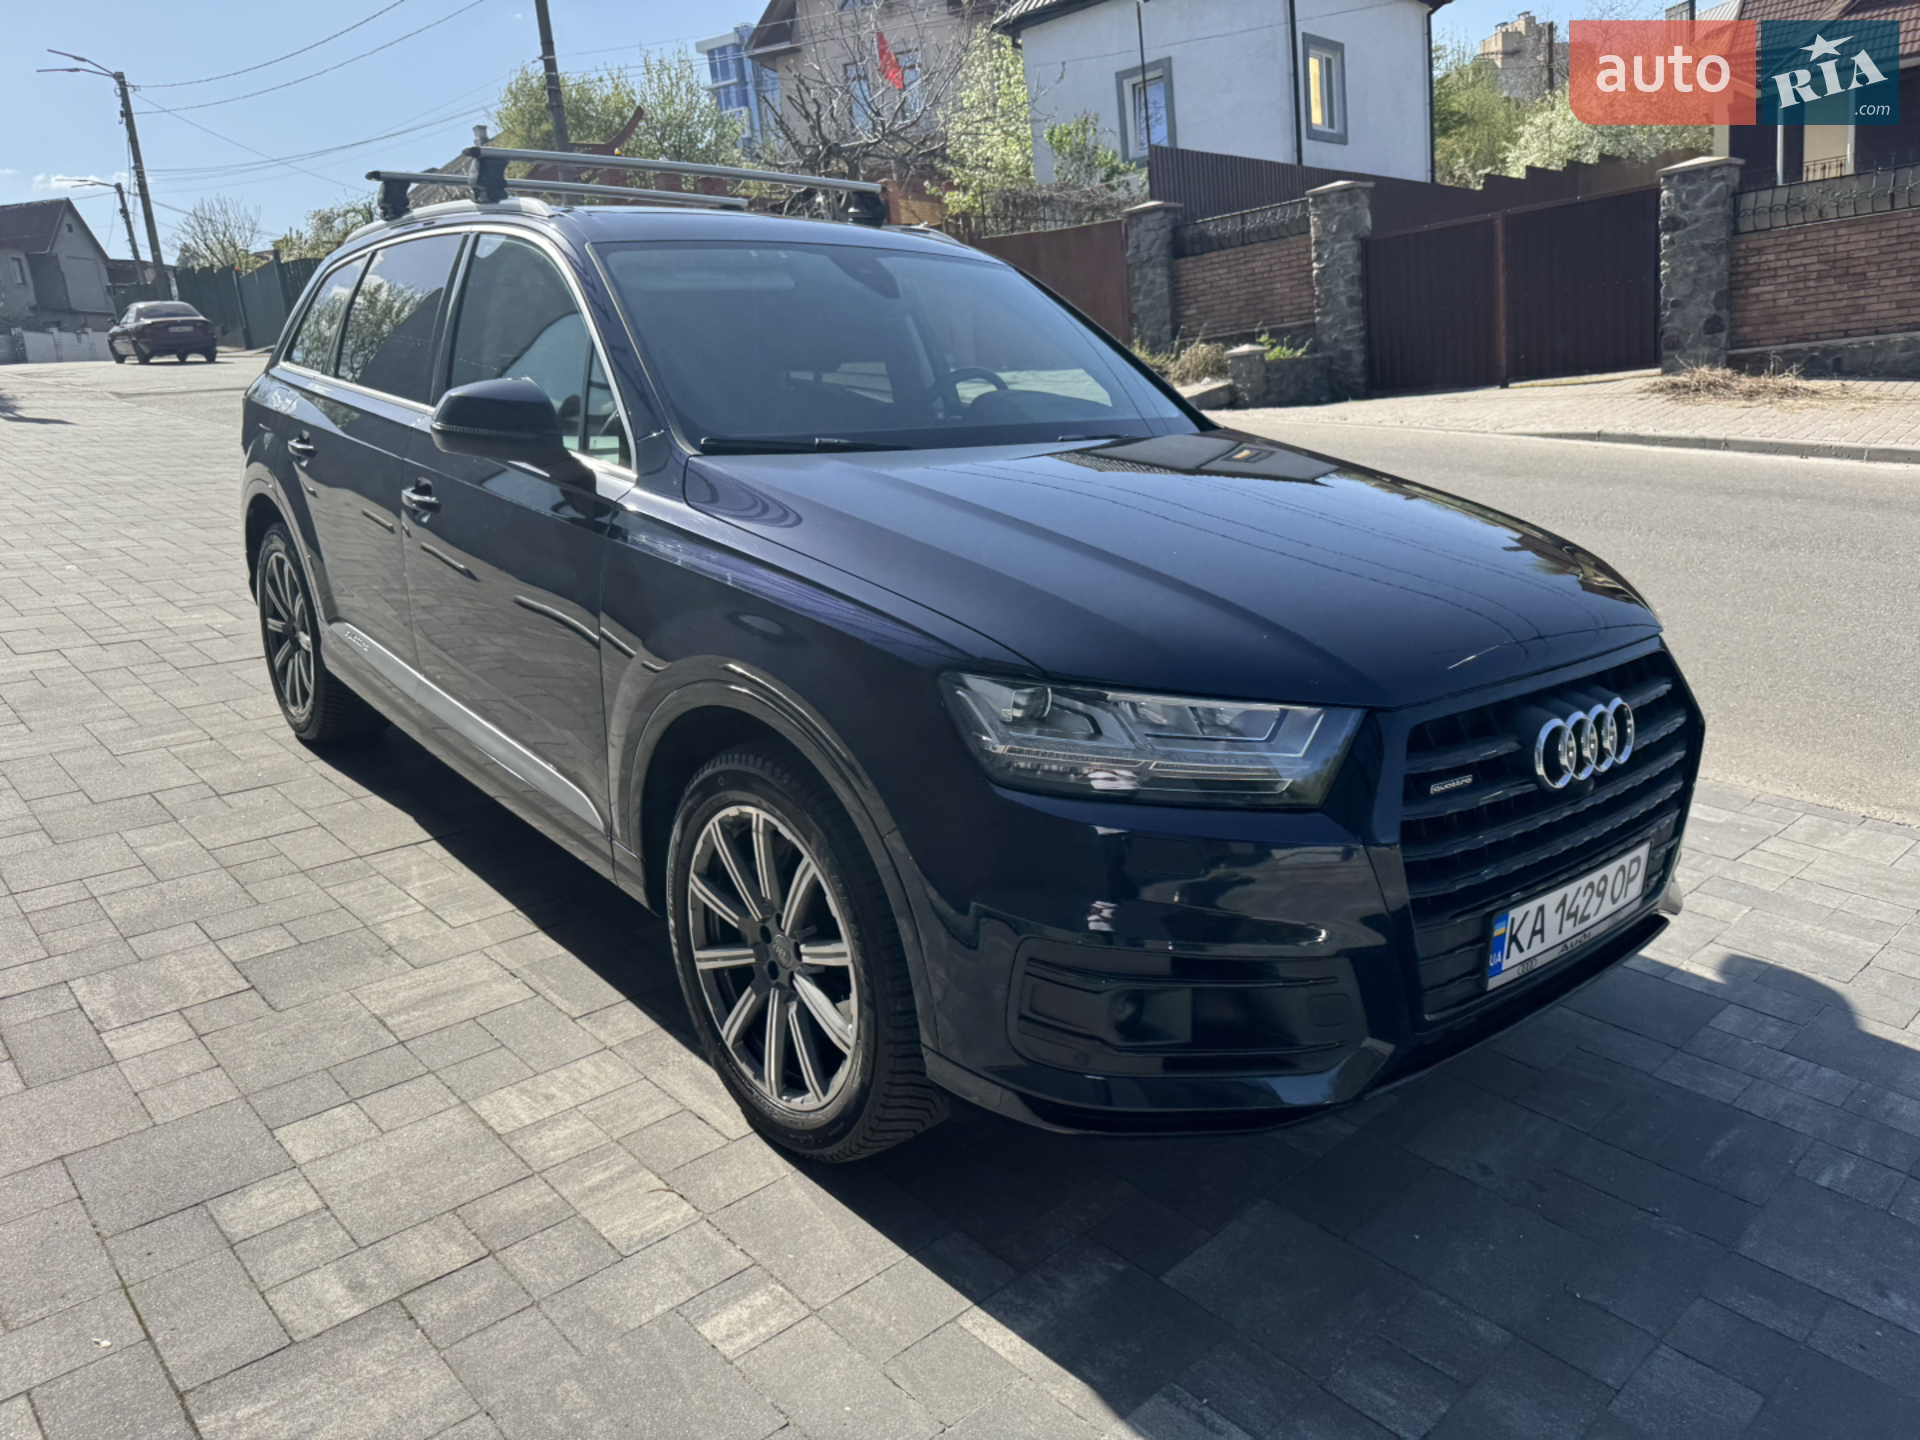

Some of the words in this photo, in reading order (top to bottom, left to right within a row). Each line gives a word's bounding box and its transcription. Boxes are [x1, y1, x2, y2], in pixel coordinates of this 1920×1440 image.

[1504, 904, 1545, 960] KA
[1555, 874, 1609, 936] 1429
[1611, 855, 1642, 905] OP
[1559, 931, 1592, 954] Audi
[1489, 951, 1502, 967] UA
